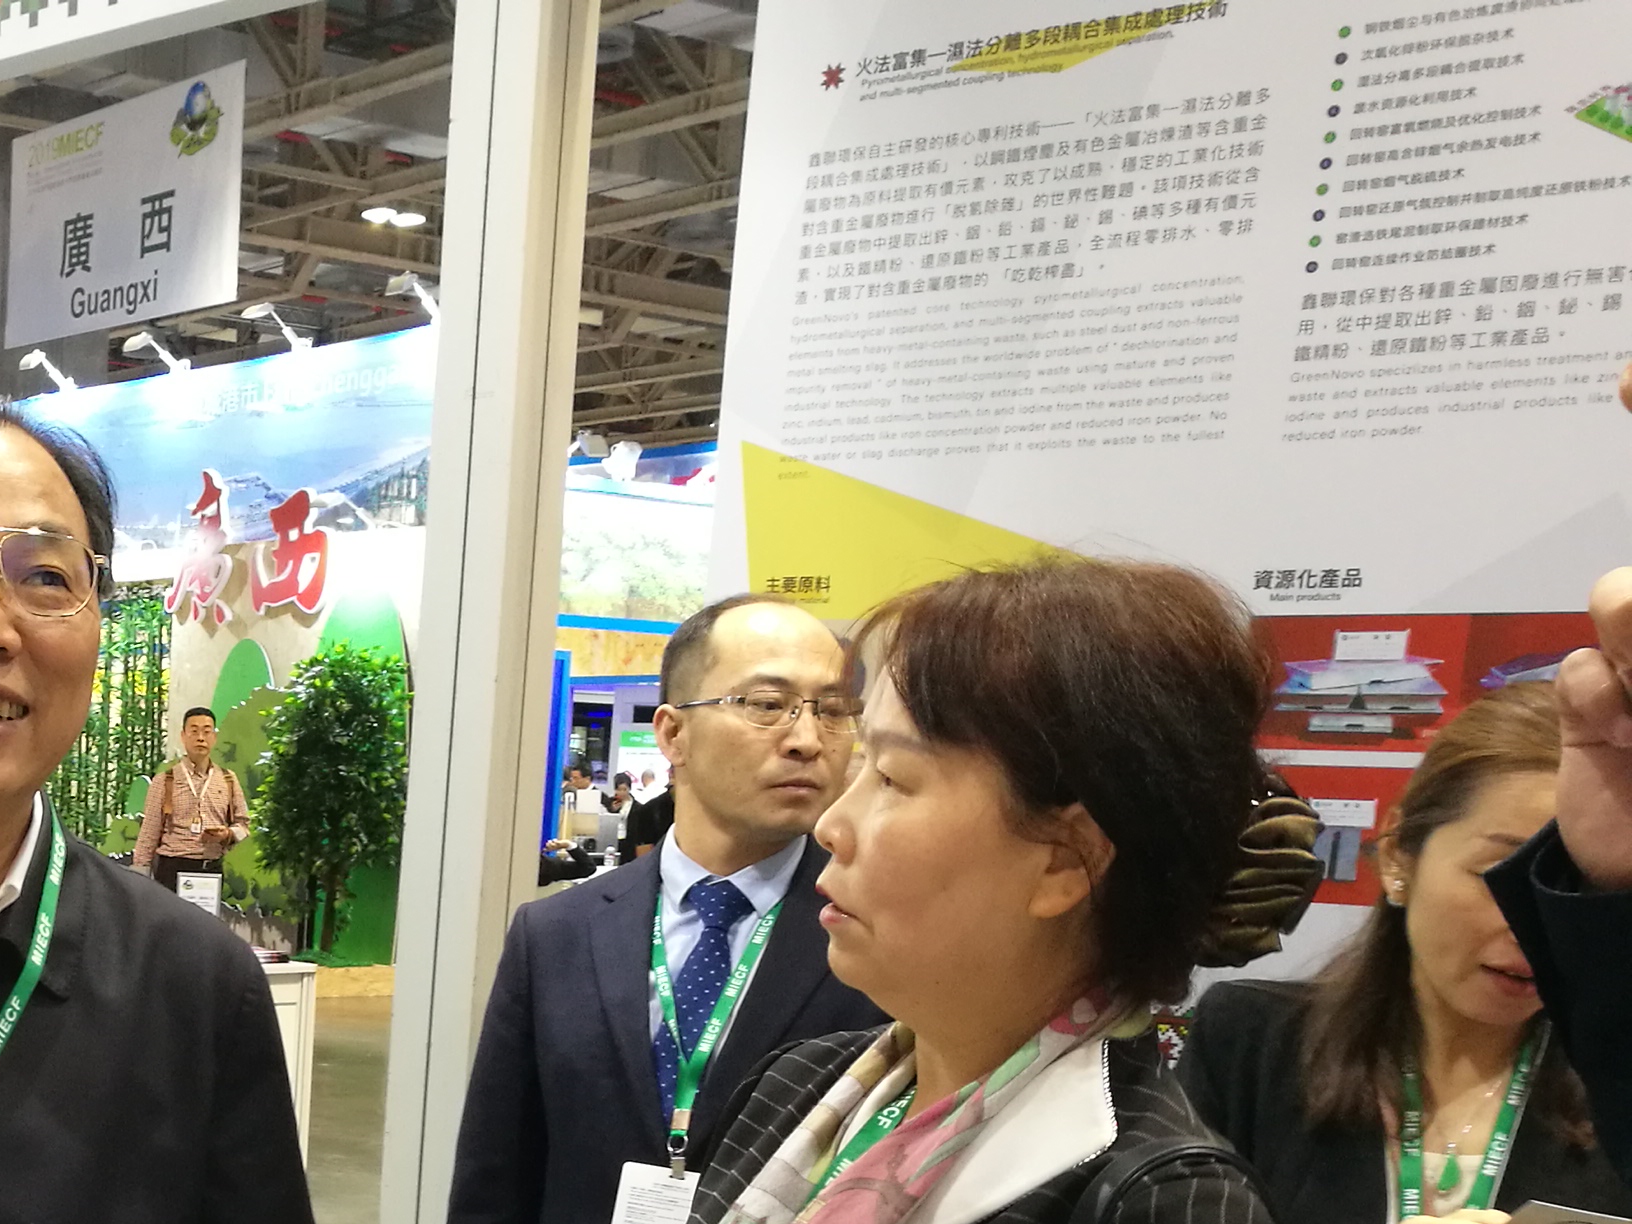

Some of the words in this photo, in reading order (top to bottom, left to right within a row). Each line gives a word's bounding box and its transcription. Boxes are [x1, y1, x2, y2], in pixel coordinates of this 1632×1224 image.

[70, 269, 159, 319] Guangxi
[766, 575, 831, 593] 主要原料
[1252, 568, 1362, 590] 資源化產品
[1269, 593, 1294, 602] Main
[1296, 592, 1341, 603] products
[49, 833, 66, 886] MIECF
[30, 912, 52, 966] MIECF
[724, 963, 749, 998] MIECF
[698, 1017, 723, 1052] MIECF
[1481, 1131, 1509, 1177] MIECF
